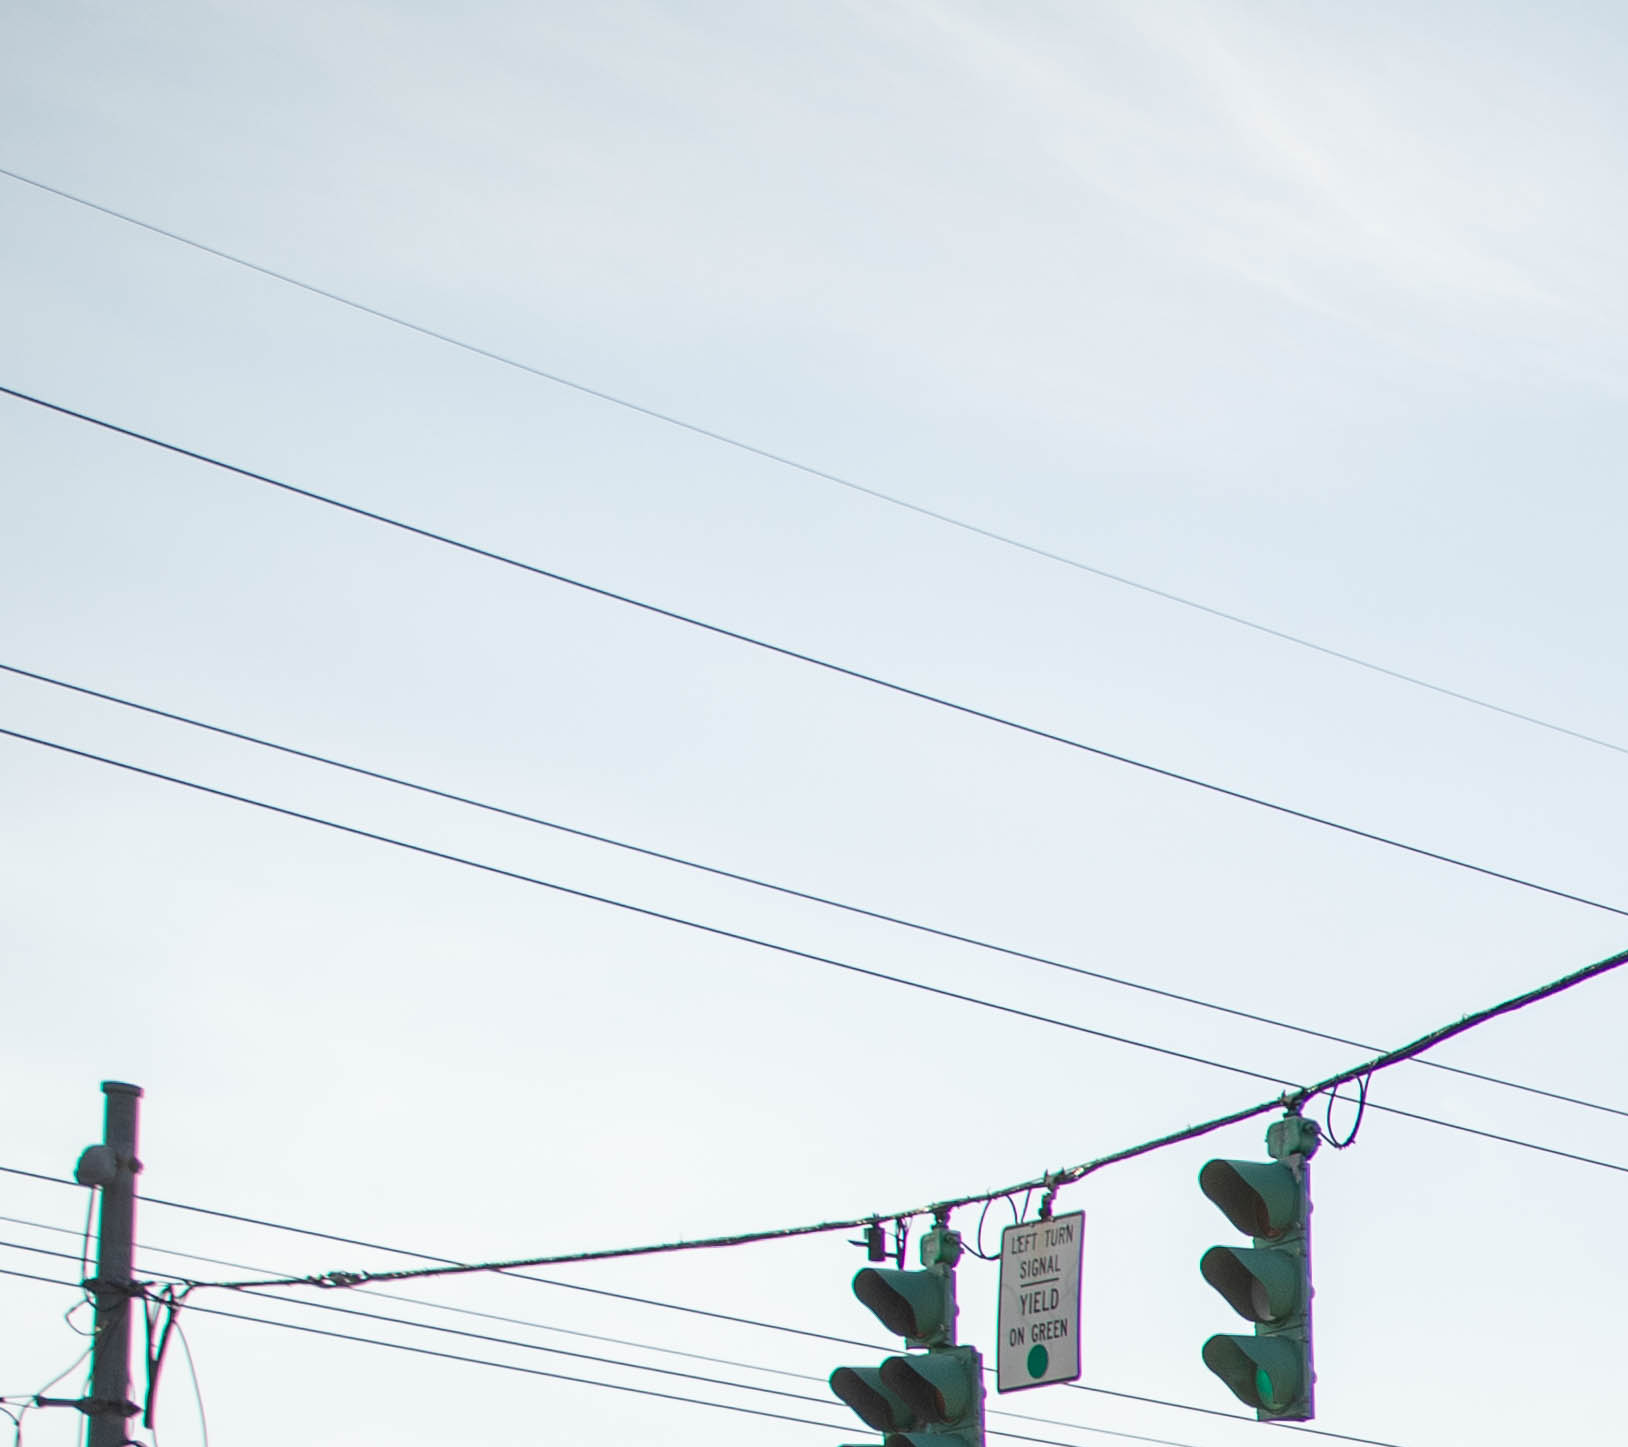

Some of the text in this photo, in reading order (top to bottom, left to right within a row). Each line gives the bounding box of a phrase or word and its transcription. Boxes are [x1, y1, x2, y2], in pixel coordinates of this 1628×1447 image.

[1011, 1224, 1074, 1254] LEFT TURN
[1020, 1254, 1061, 1279] SIGNAL
[1020, 1288, 1059, 1316] YIELD
[1009, 1318, 1068, 1347] ON GREEN
